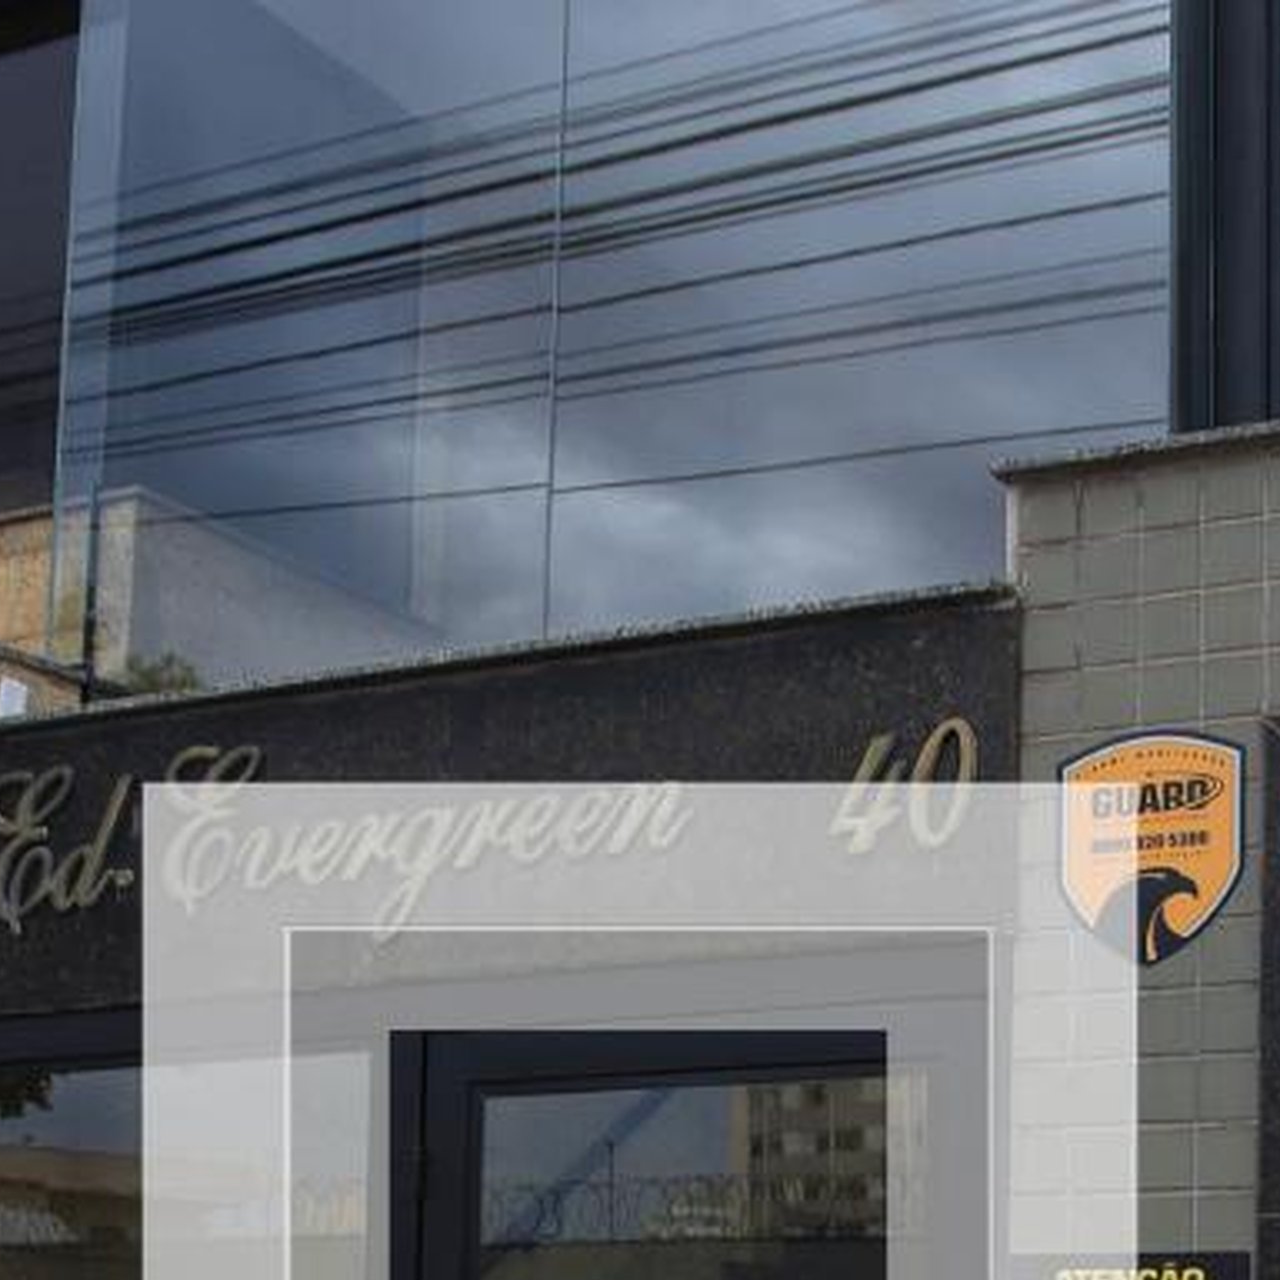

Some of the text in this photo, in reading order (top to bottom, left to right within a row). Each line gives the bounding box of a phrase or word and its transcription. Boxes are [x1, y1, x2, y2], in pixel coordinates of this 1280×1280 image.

[163, 745, 694, 941] Evergreen
[828, 715, 981, 854] 40
[1091, 774, 1224, 819] GUARD
